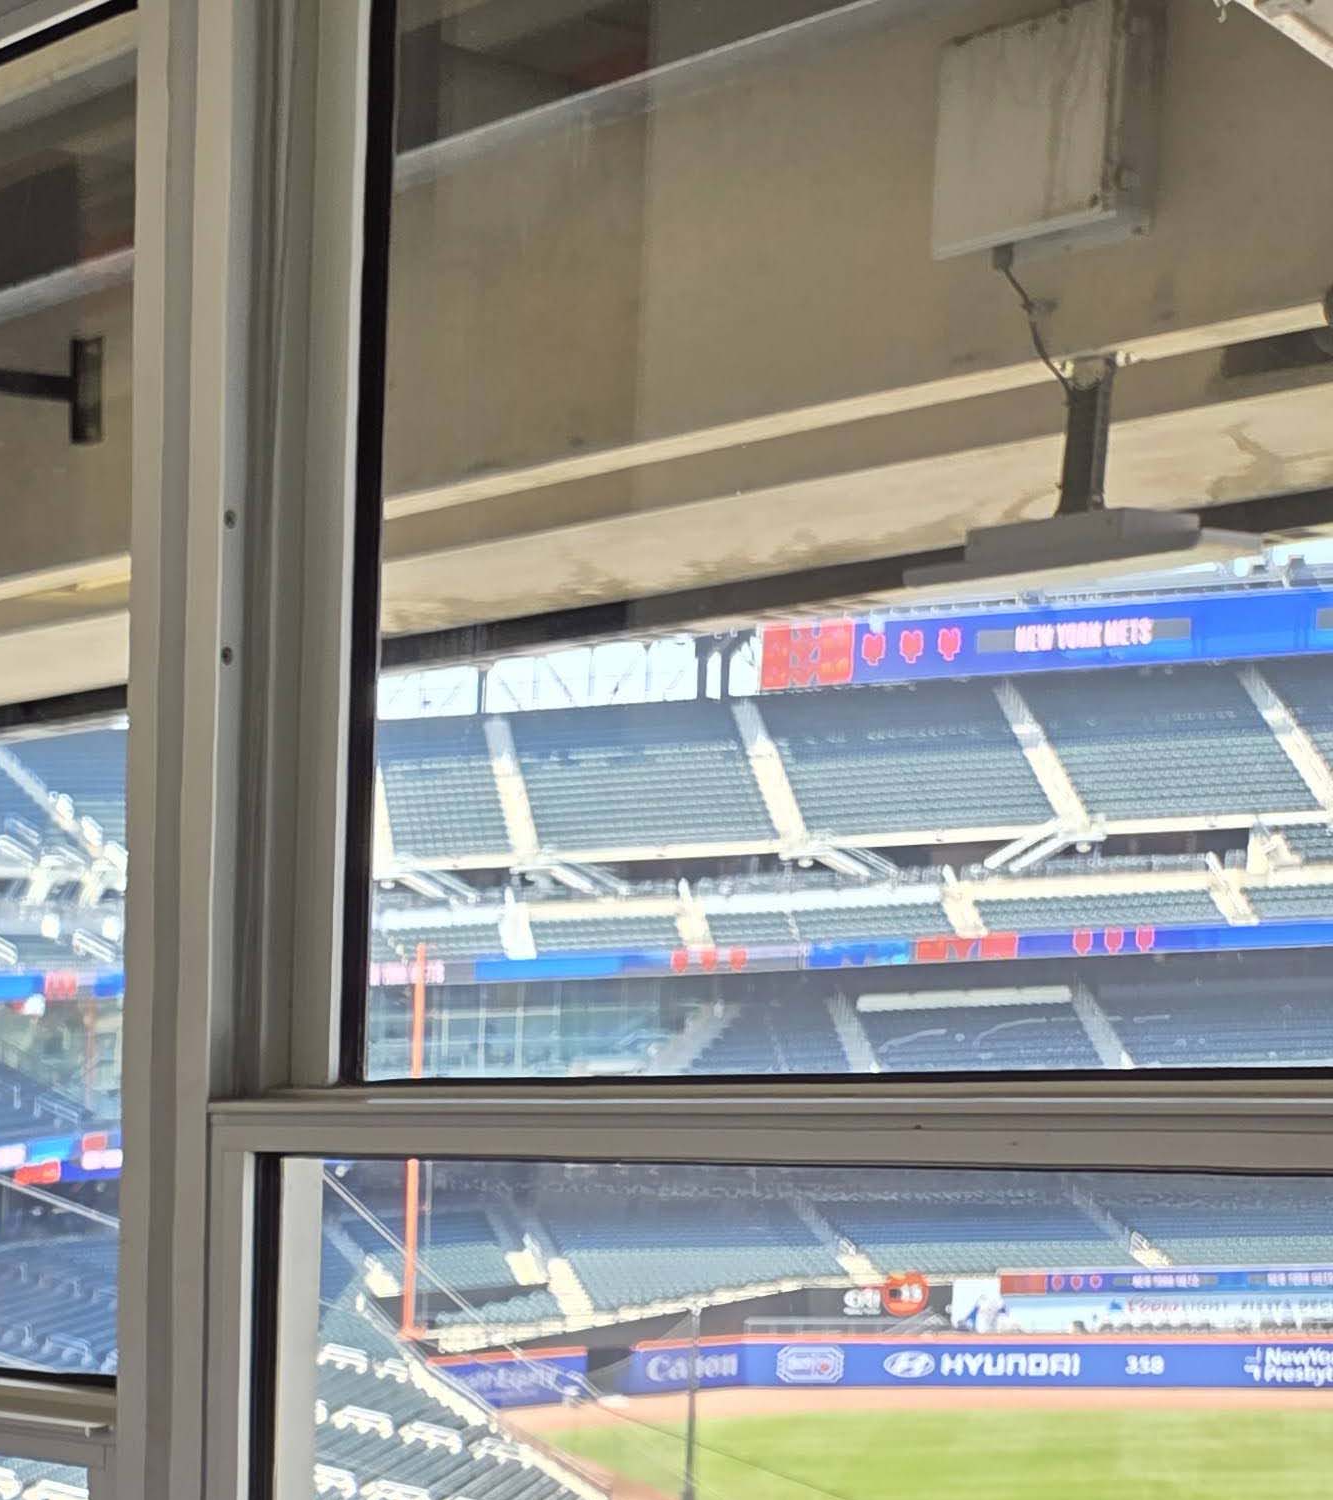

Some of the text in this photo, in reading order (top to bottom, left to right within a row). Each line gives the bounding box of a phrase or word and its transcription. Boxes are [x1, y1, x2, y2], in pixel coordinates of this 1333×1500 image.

[1014, 624, 1055, 652] NEW
[1104, 617, 1154, 647] METS
[940, 1352, 1081, 1377] HYUNDAI
